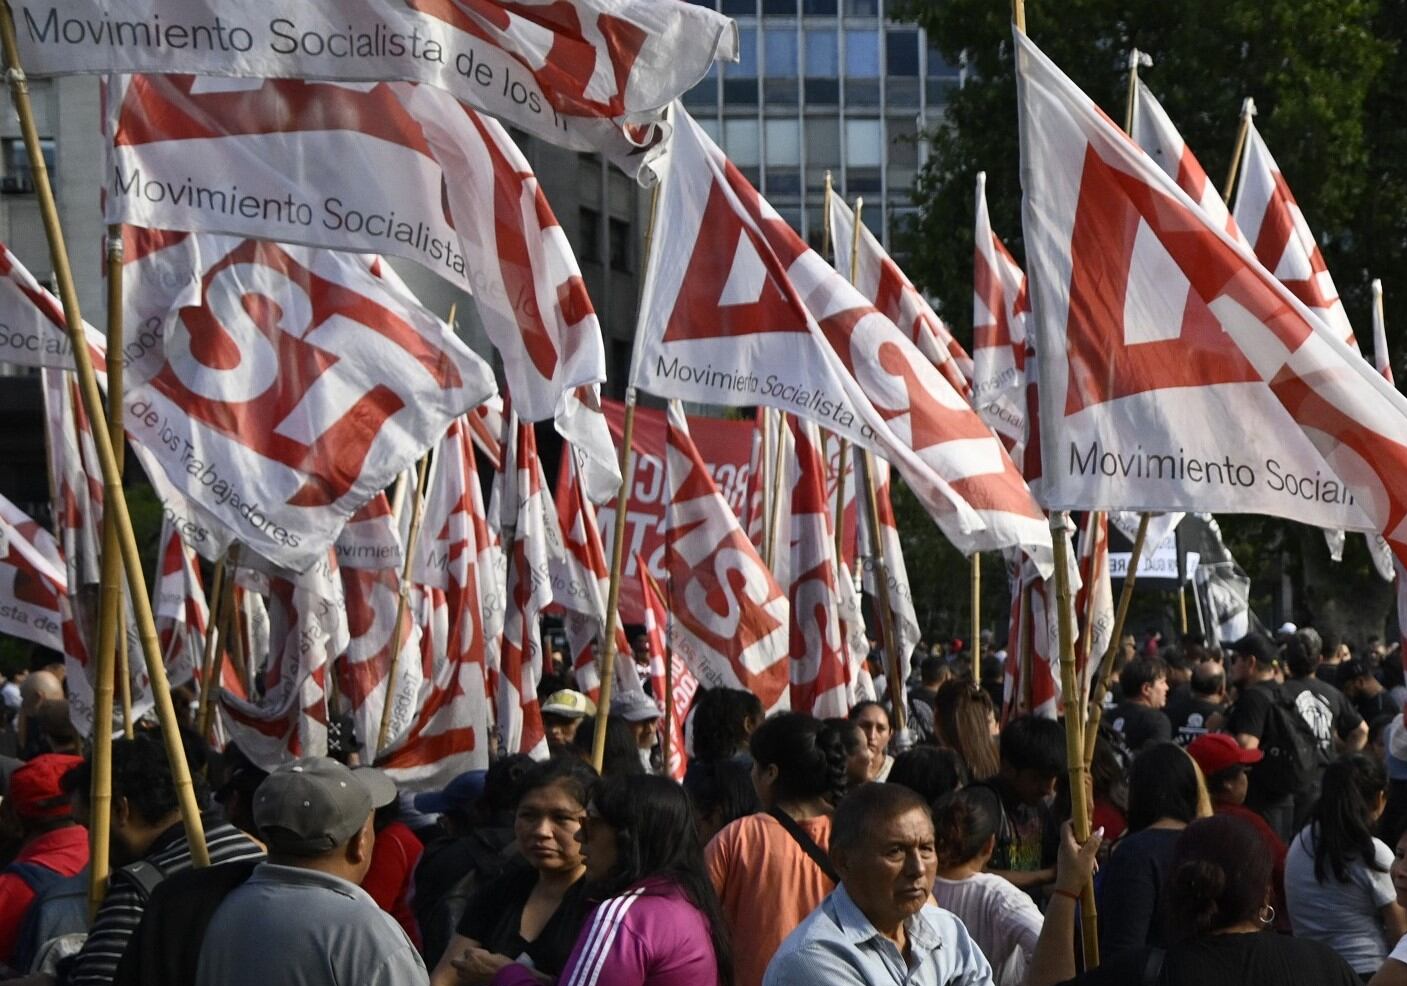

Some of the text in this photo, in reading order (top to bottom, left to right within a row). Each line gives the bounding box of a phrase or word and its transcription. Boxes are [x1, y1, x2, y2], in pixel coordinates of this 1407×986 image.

[23, 7, 253, 52] Movimiento
[269, 18, 446, 64] Socialista
[455, 49, 493, 87] de
[503, 67, 541, 113] los
[114, 166, 312, 225] Movimiento
[323, 198, 466, 278] Socialista
[656, 355, 759, 393] Movimiento
[761, 374, 855, 428] Socialista
[130, 400, 302, 548] de los Trabajadores
[1069, 441, 1255, 487] Movimiento
[34, 614, 59, 635] de
